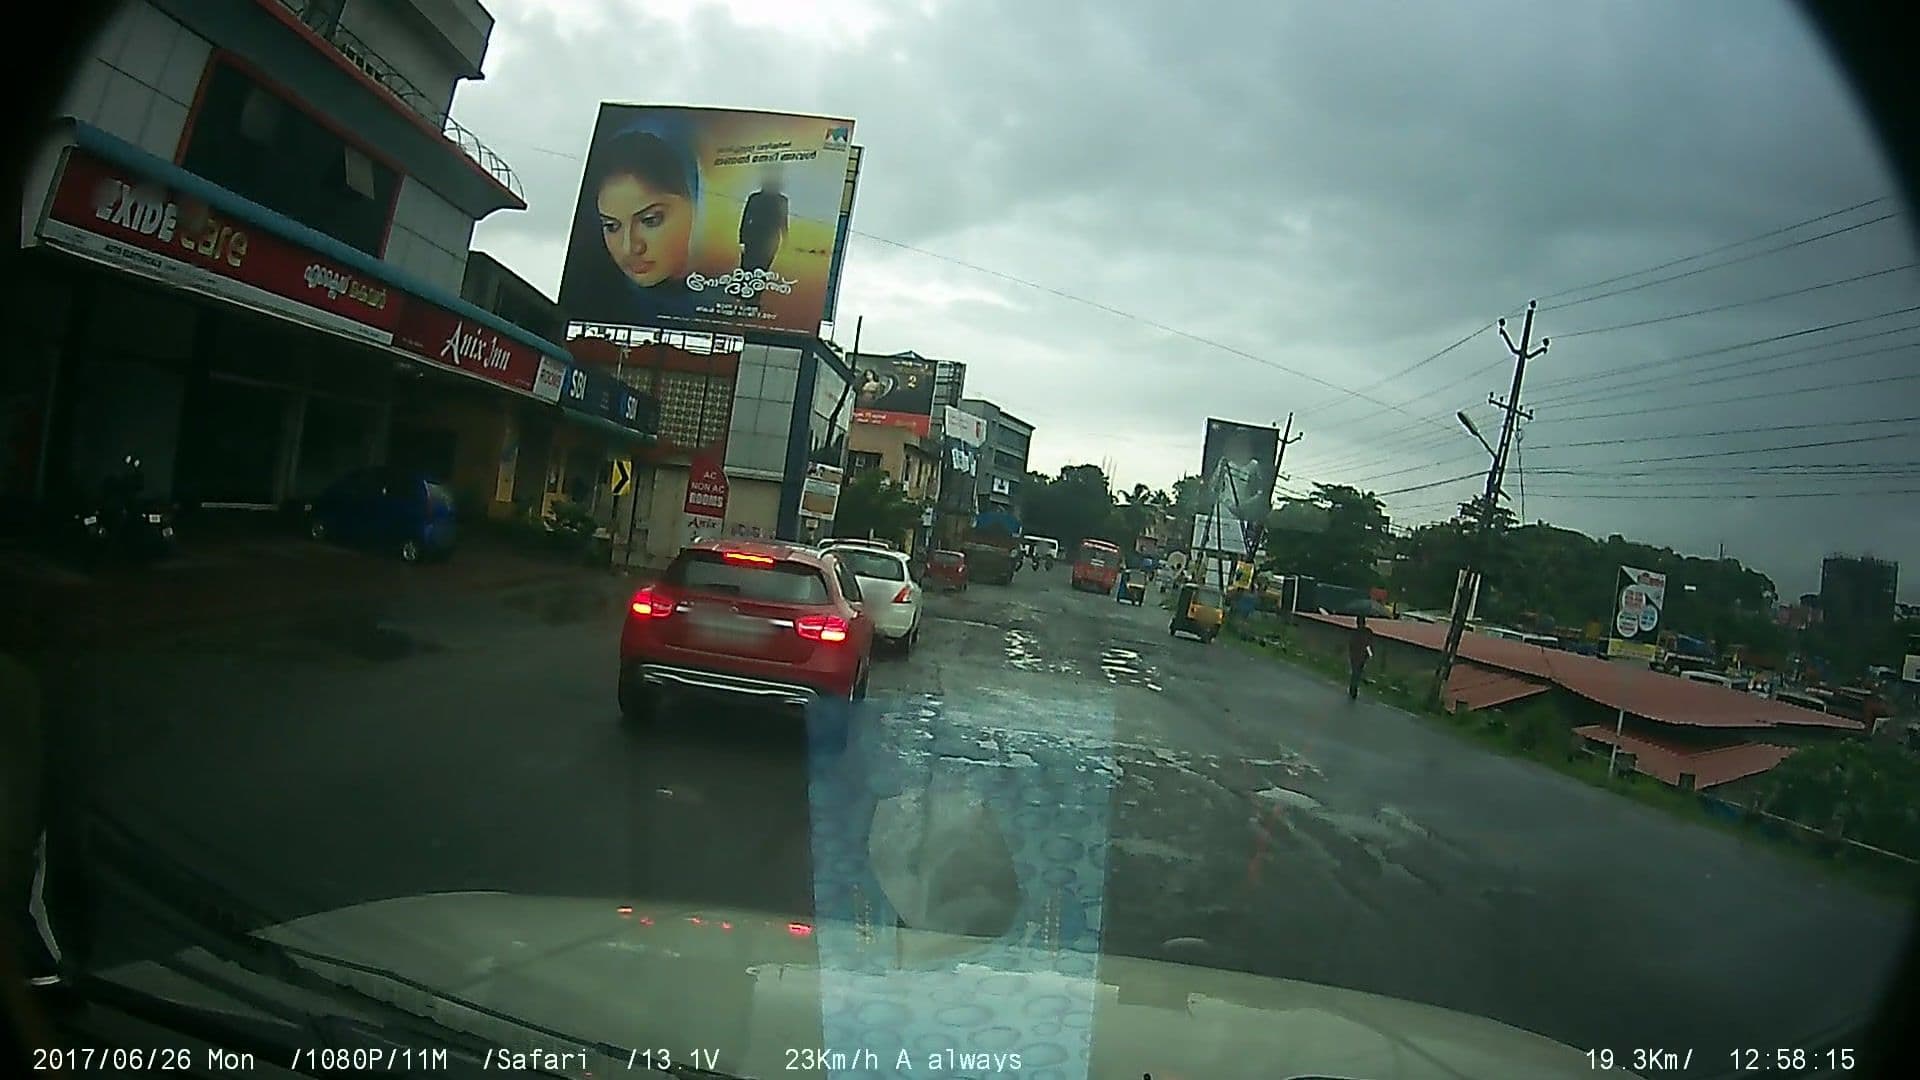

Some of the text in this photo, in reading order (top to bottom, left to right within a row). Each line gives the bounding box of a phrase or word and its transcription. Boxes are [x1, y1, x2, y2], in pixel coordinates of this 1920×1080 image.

[96, 180, 177, 243] EXIDE
[440, 320, 487, 365] Anix
[570, 369, 588, 401] SBI
[703, 471, 718, 480] AC
[689, 492, 724, 508] ROOMS
[711, 484, 725, 494] AC
